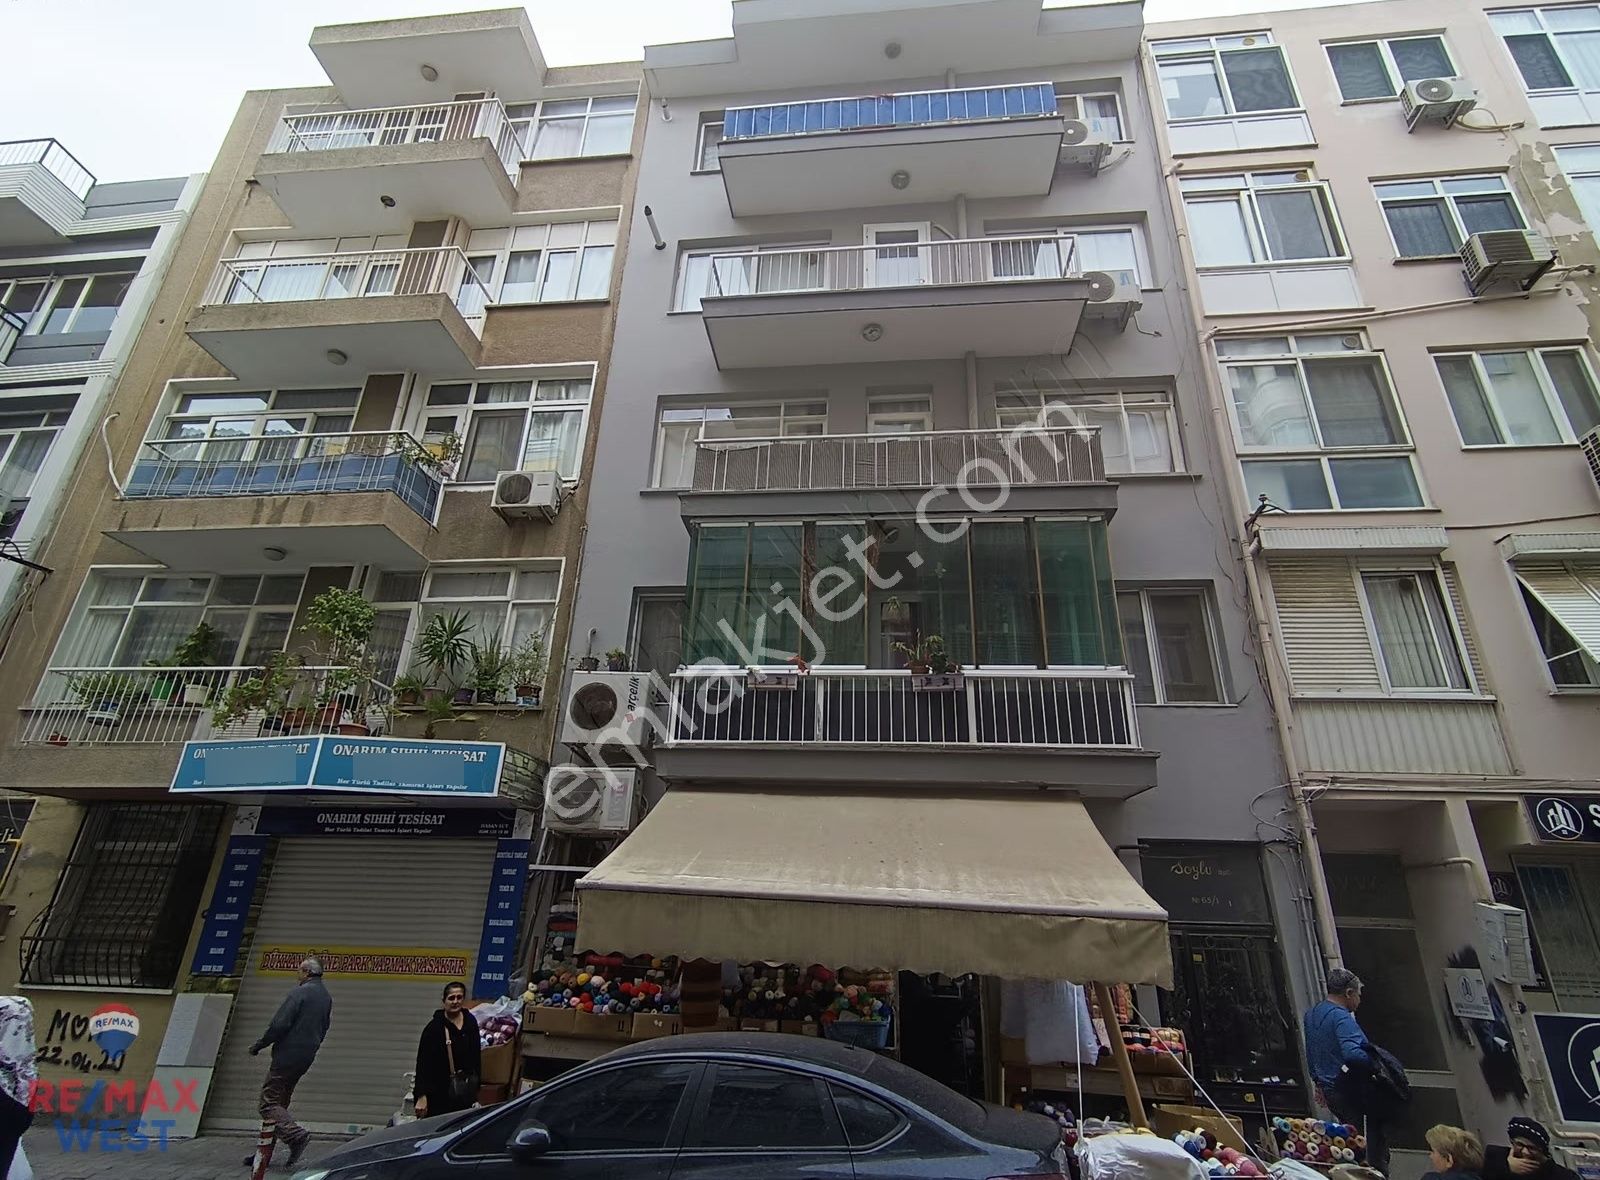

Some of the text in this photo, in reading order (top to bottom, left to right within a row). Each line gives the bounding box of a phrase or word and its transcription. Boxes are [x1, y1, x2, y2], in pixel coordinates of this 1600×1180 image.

[626, 676, 639, 711] arçelik
[317, 811, 446, 825] ONARIM SIHHİ TESİSAT
[340, 953, 369, 973] PARK
[370, 954, 413, 975] YAPMAK
